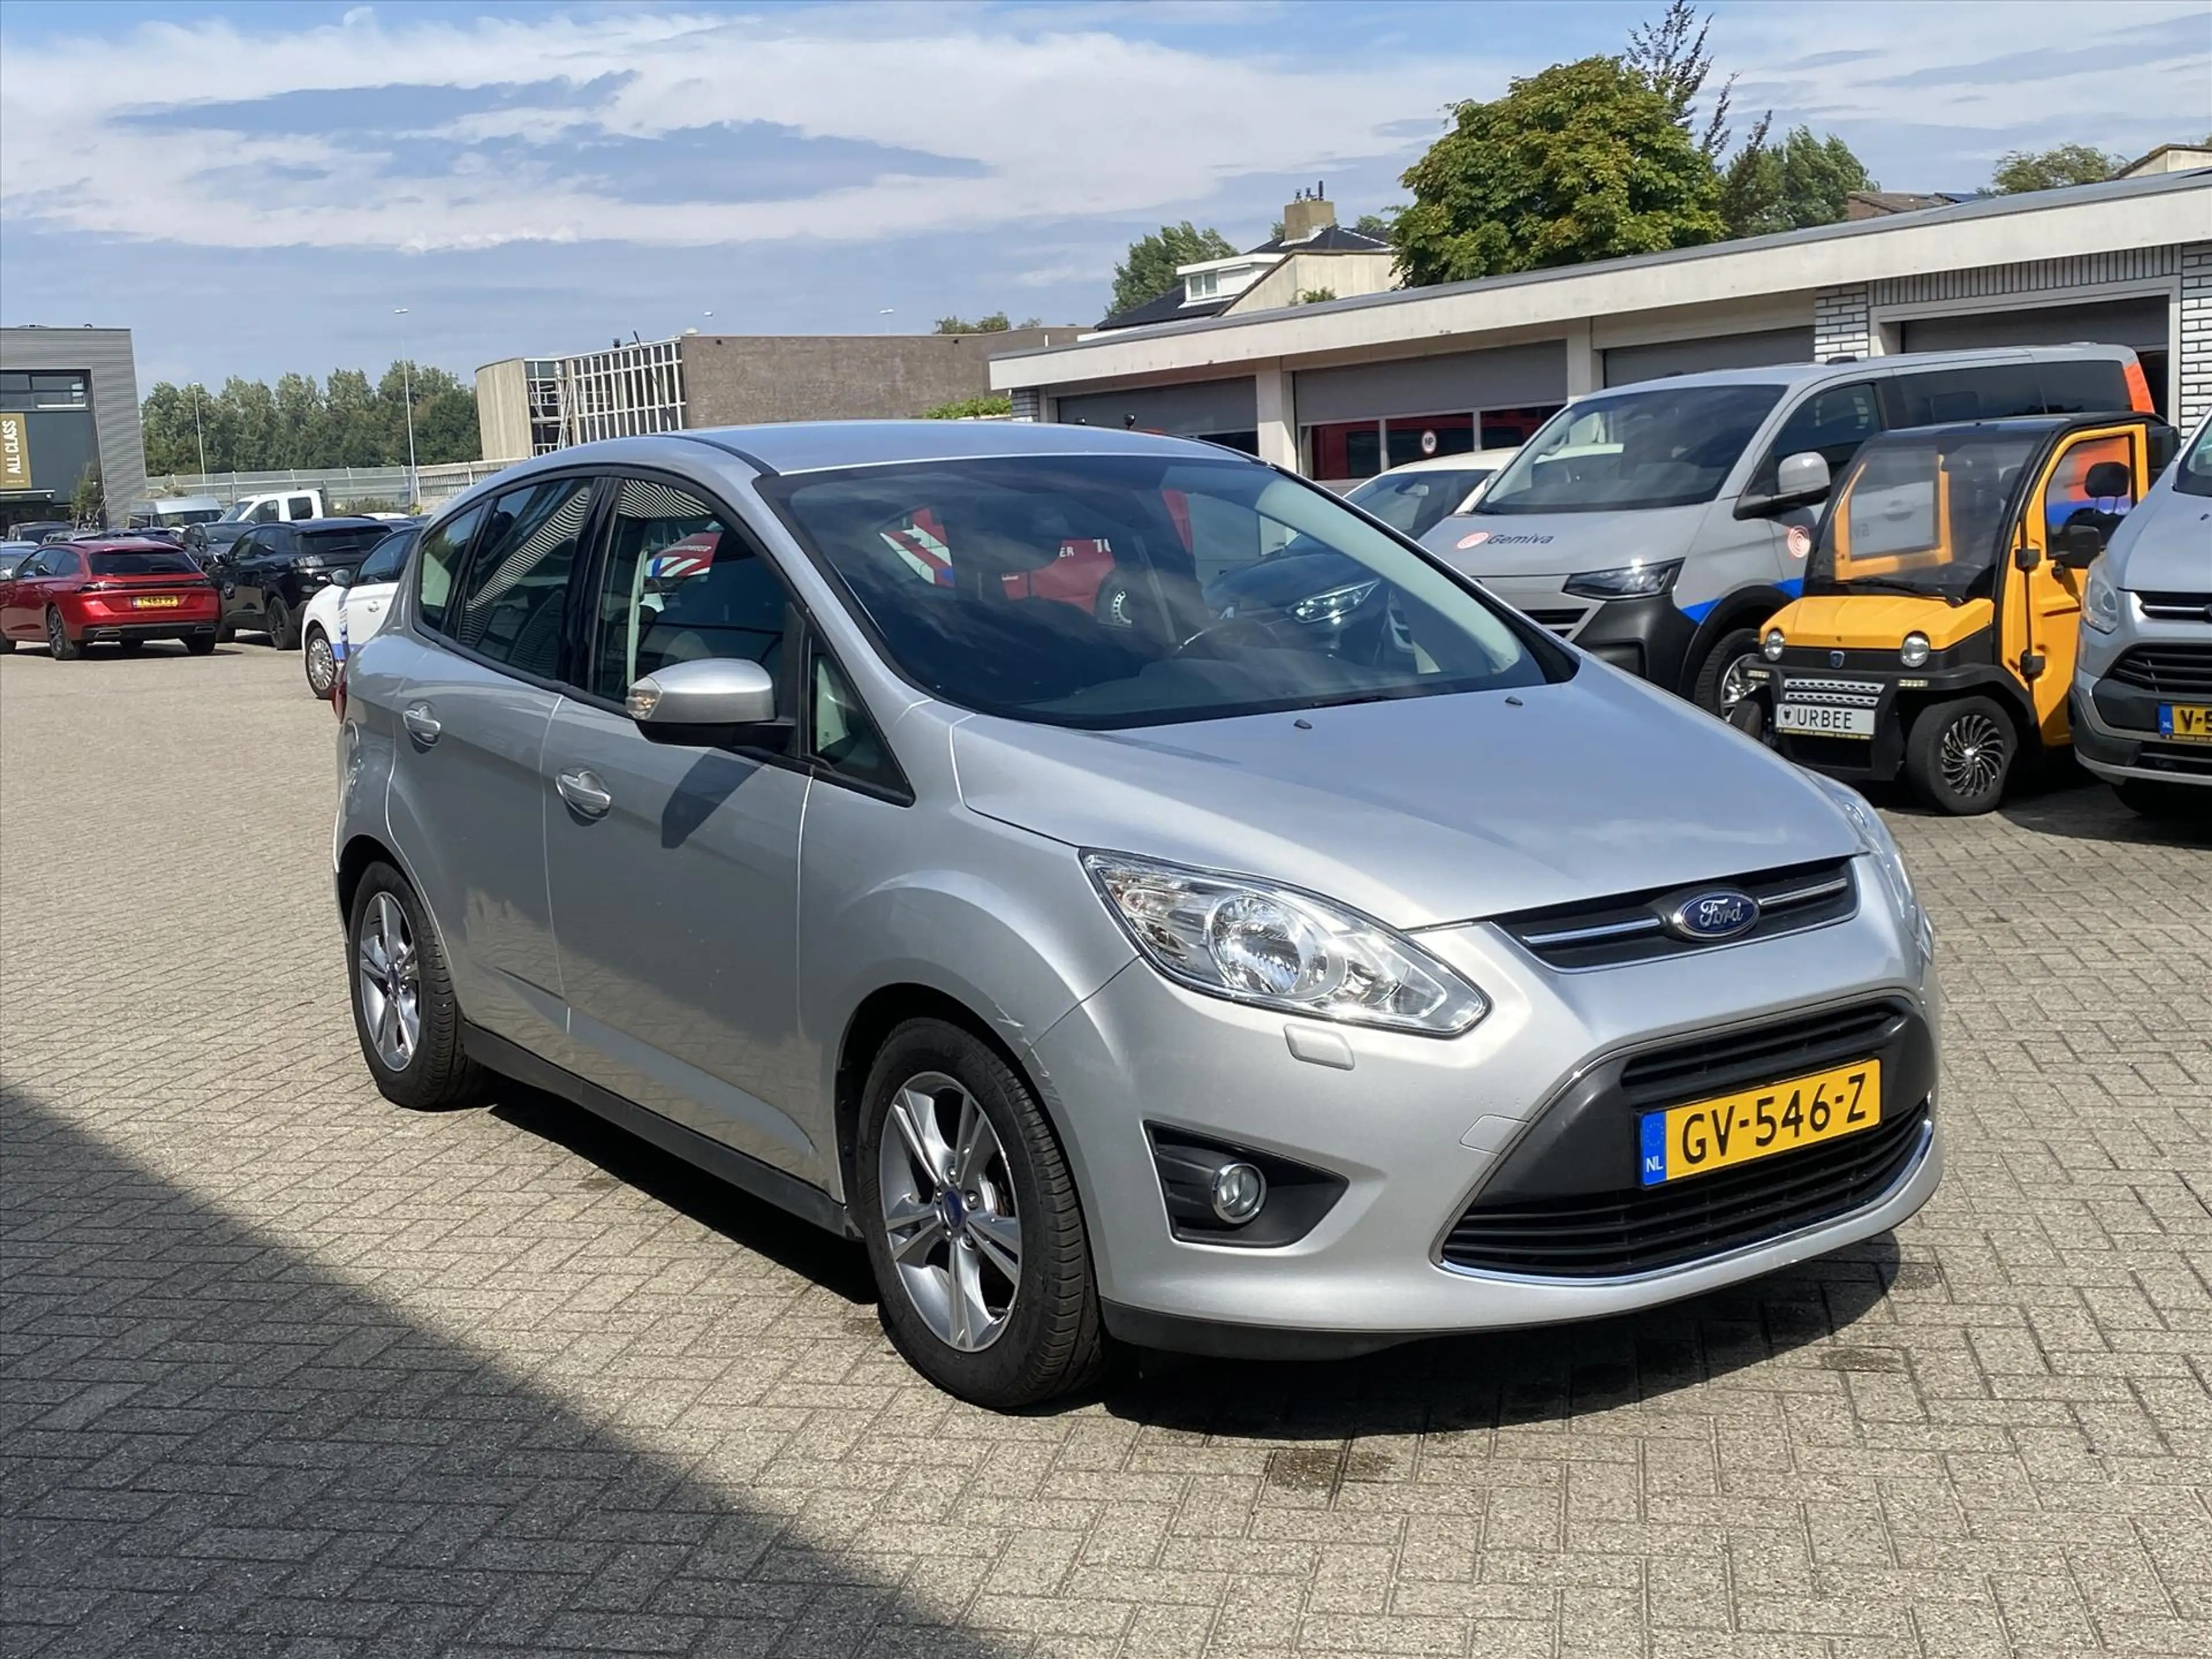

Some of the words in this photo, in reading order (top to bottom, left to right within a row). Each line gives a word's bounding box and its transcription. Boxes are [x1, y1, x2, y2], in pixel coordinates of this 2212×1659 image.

[2, 420, 19, 453] CLASS
[6, 454, 21, 475] ALL
[1487, 533, 1554, 544] Gemiva
[1798, 709, 1853, 729] URBEE
[1699, 898, 1744, 927] Ford
[1646, 1156, 1664, 1173] NL
[1682, 1072, 1866, 1165] GV-546-Z
